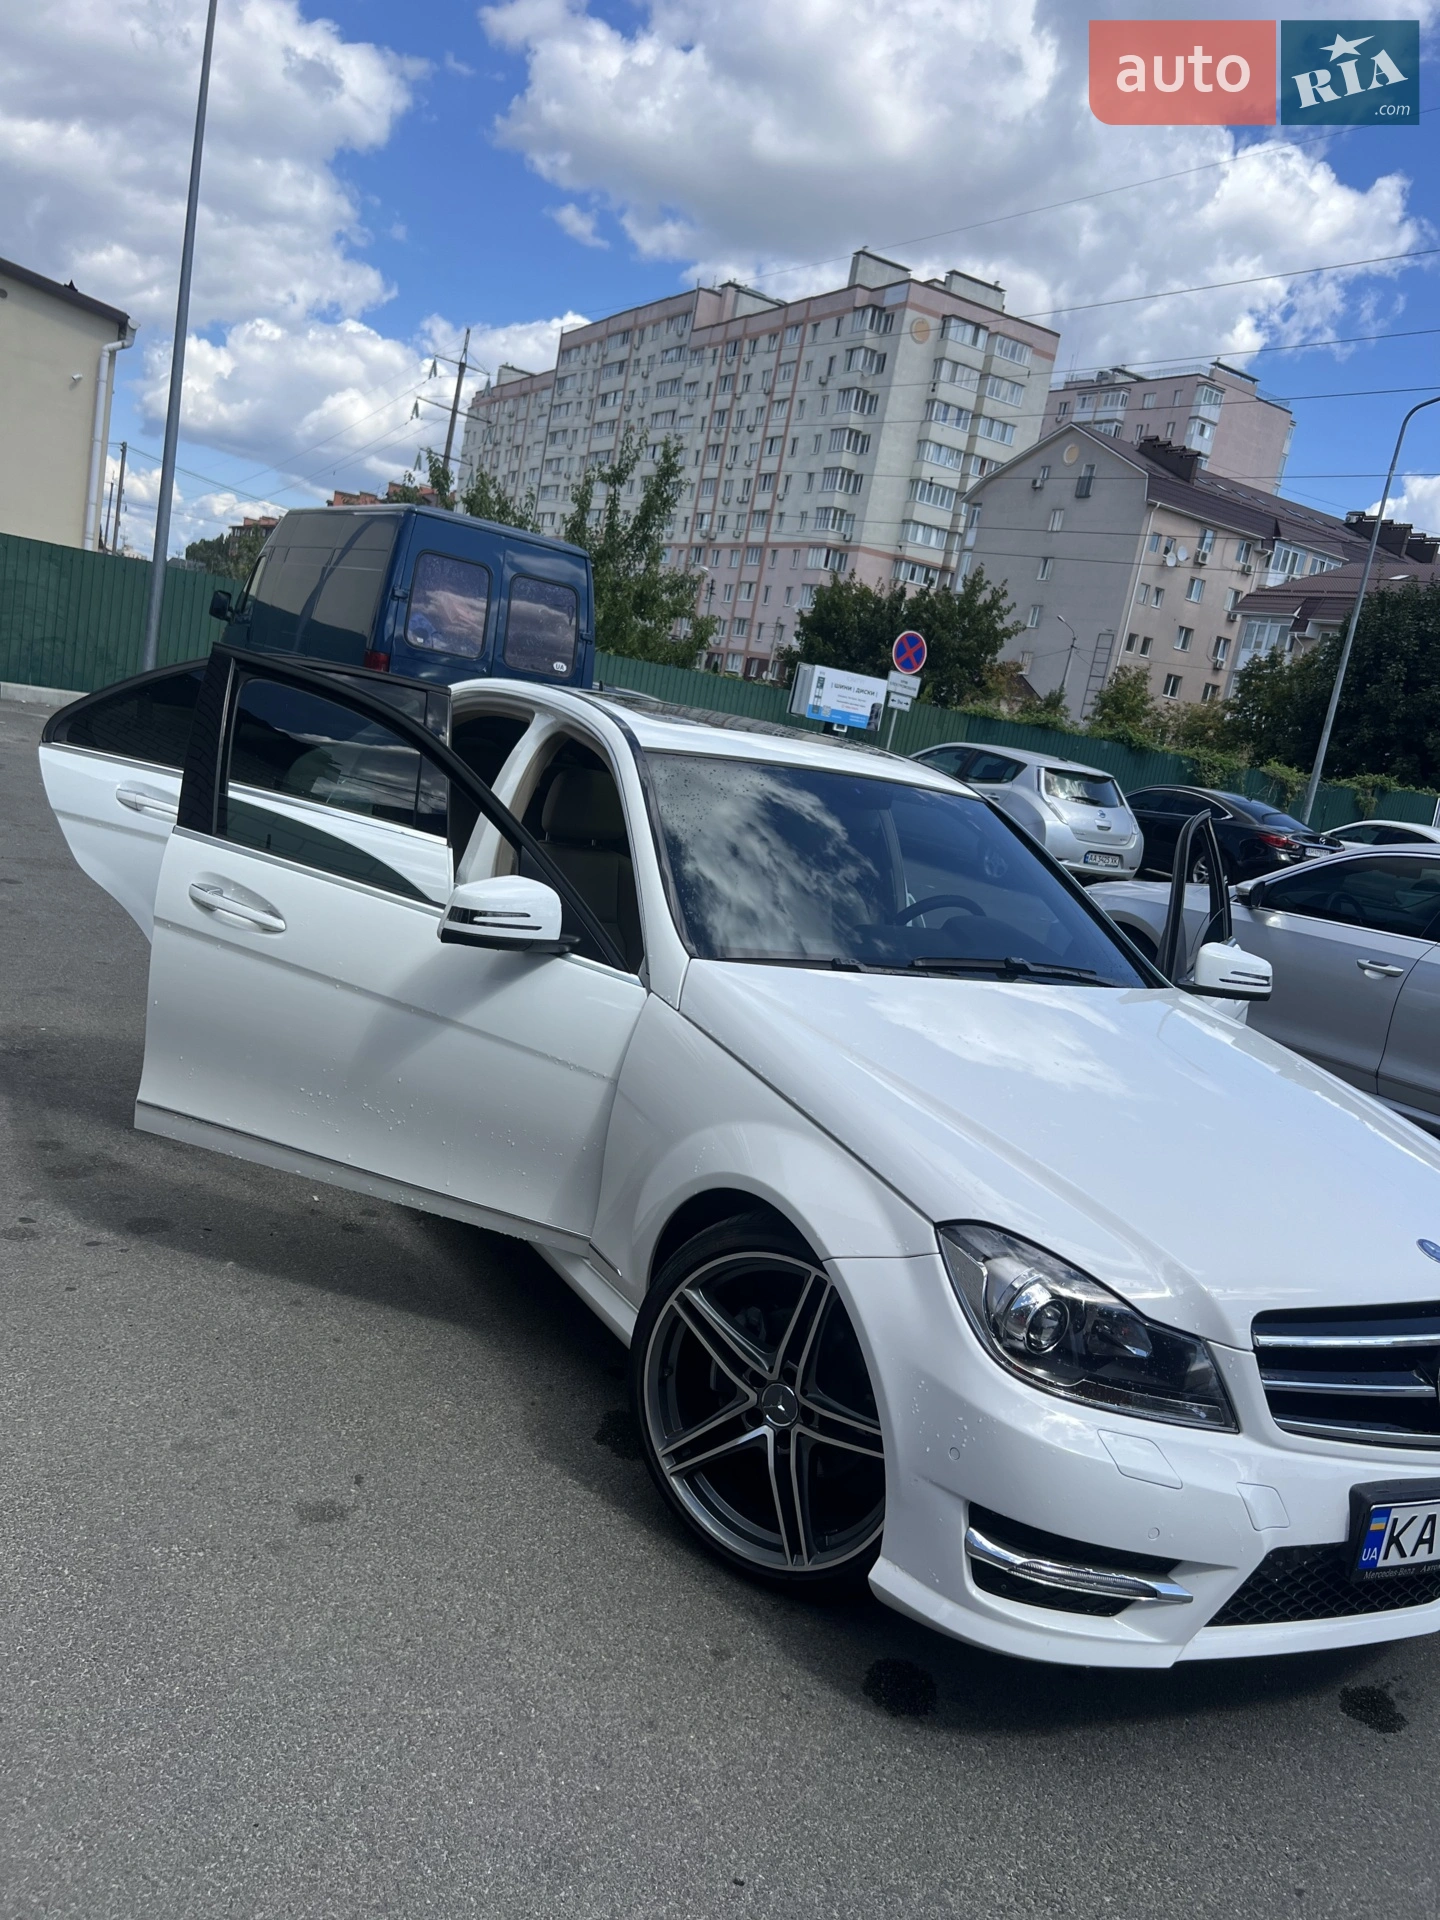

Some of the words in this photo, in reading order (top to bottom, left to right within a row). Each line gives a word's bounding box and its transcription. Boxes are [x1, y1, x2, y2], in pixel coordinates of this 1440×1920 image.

[834, 683, 852, 692] ШИНИ
[856, 686, 875, 697] ДИСКИ
[1382, 1514, 1438, 1560] KA
[1361, 1547, 1378, 1561] UA
[1363, 1567, 1416, 1580] Mercedes-Benz
